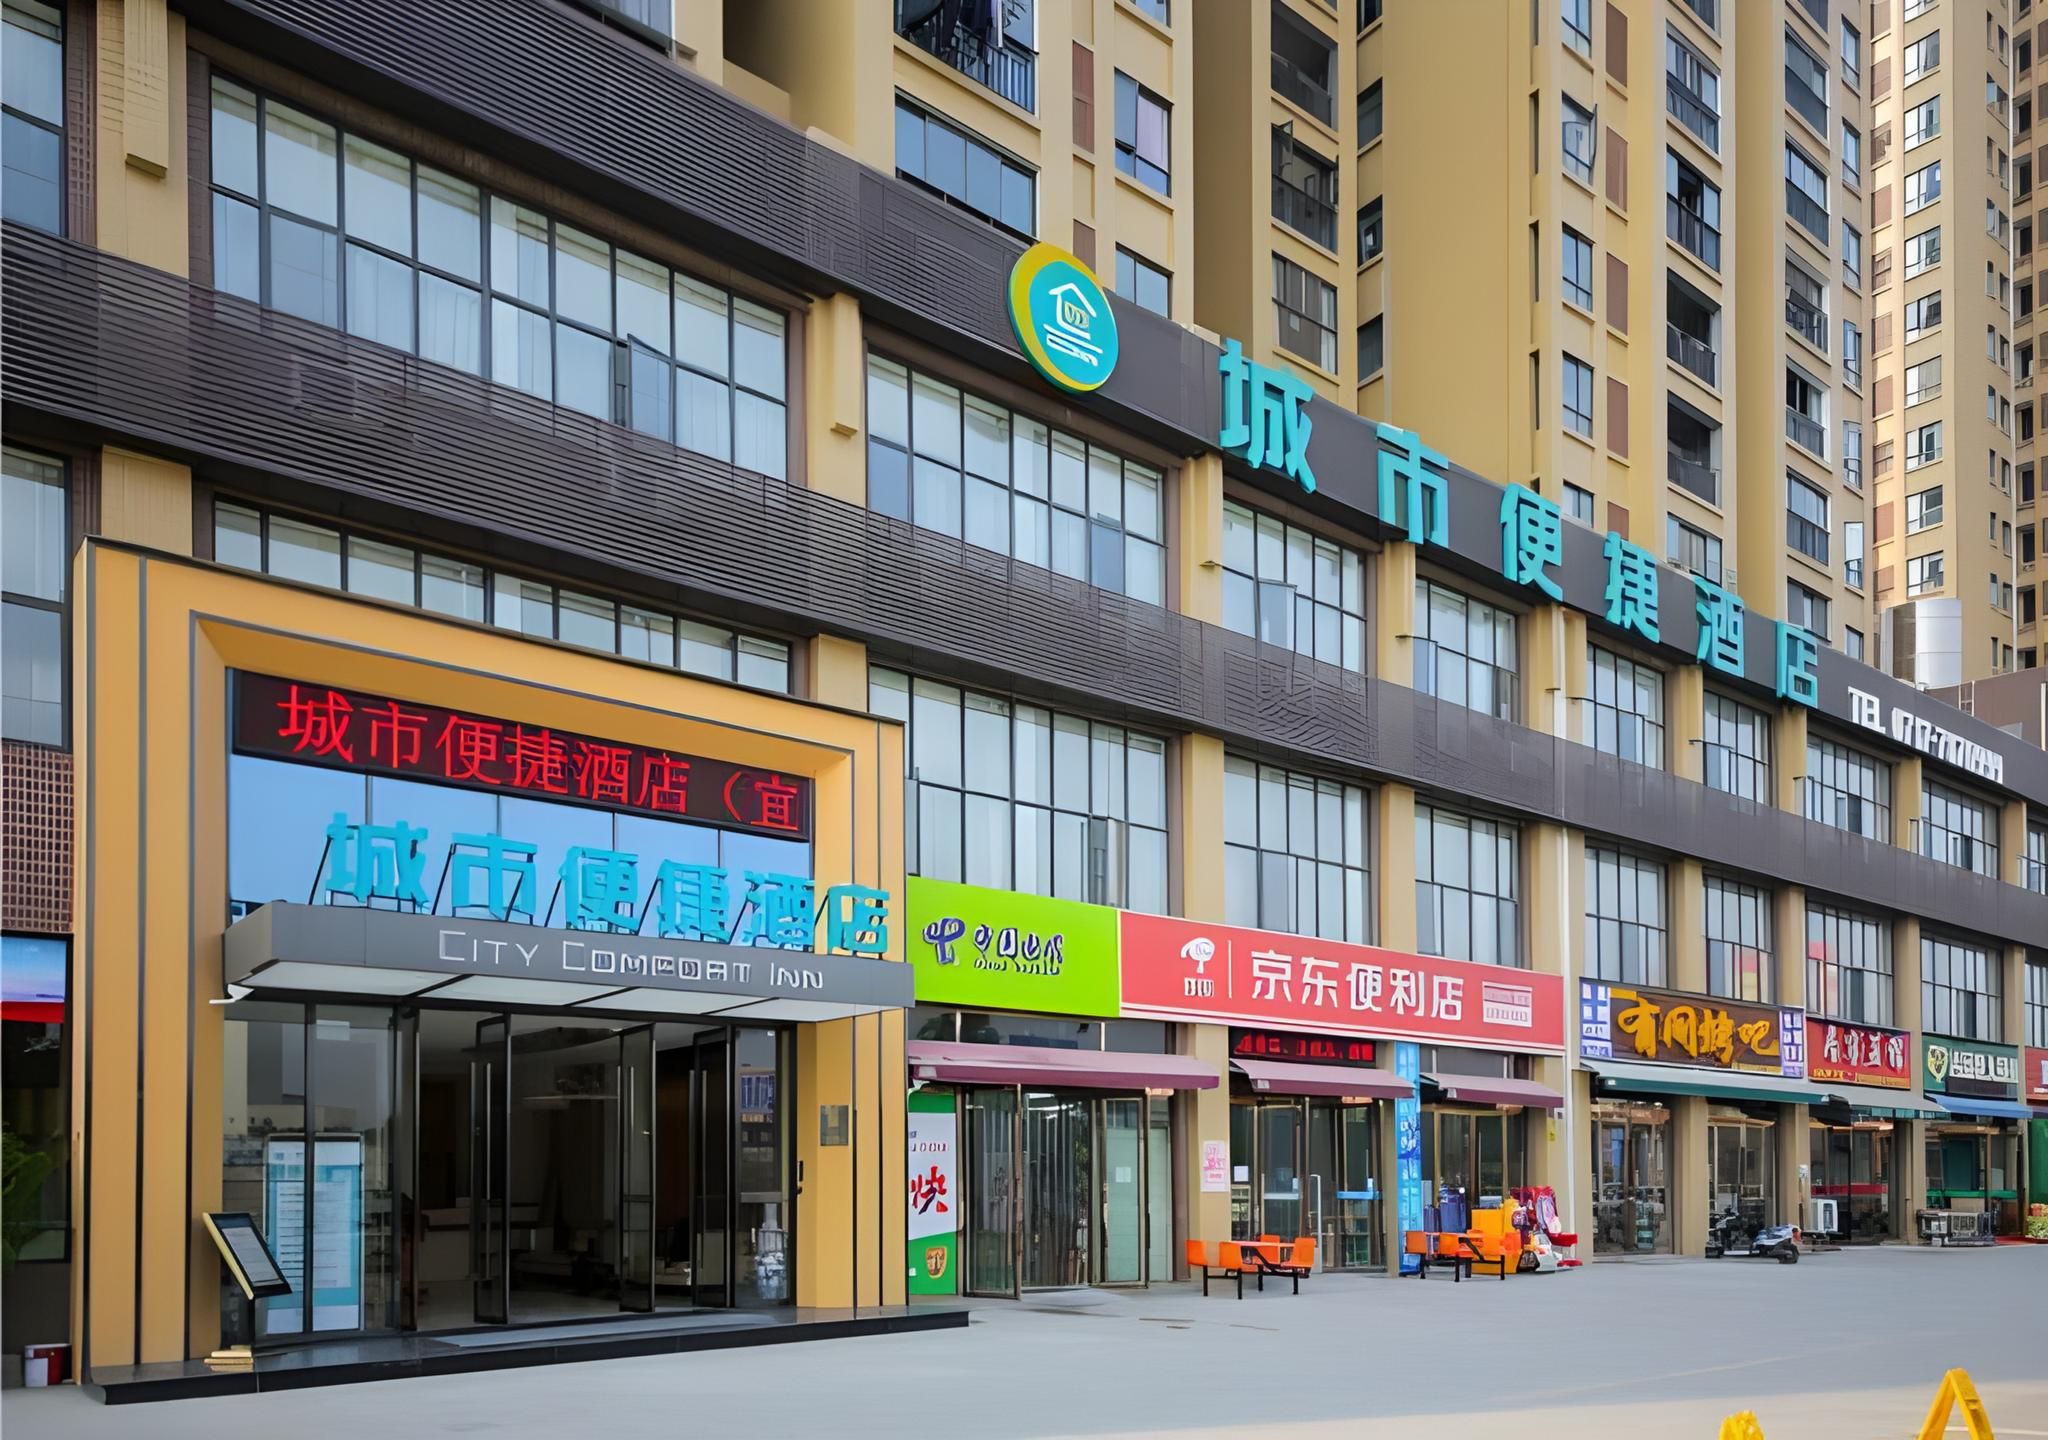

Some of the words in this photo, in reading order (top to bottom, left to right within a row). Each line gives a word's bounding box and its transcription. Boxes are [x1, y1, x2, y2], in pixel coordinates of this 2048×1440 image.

[1219, 338, 1820, 709] 城市便捷酒店
[439, 929, 539, 968] CITY
[770, 961, 824, 990] INN
[1251, 949, 1465, 1022] 京东便利店
